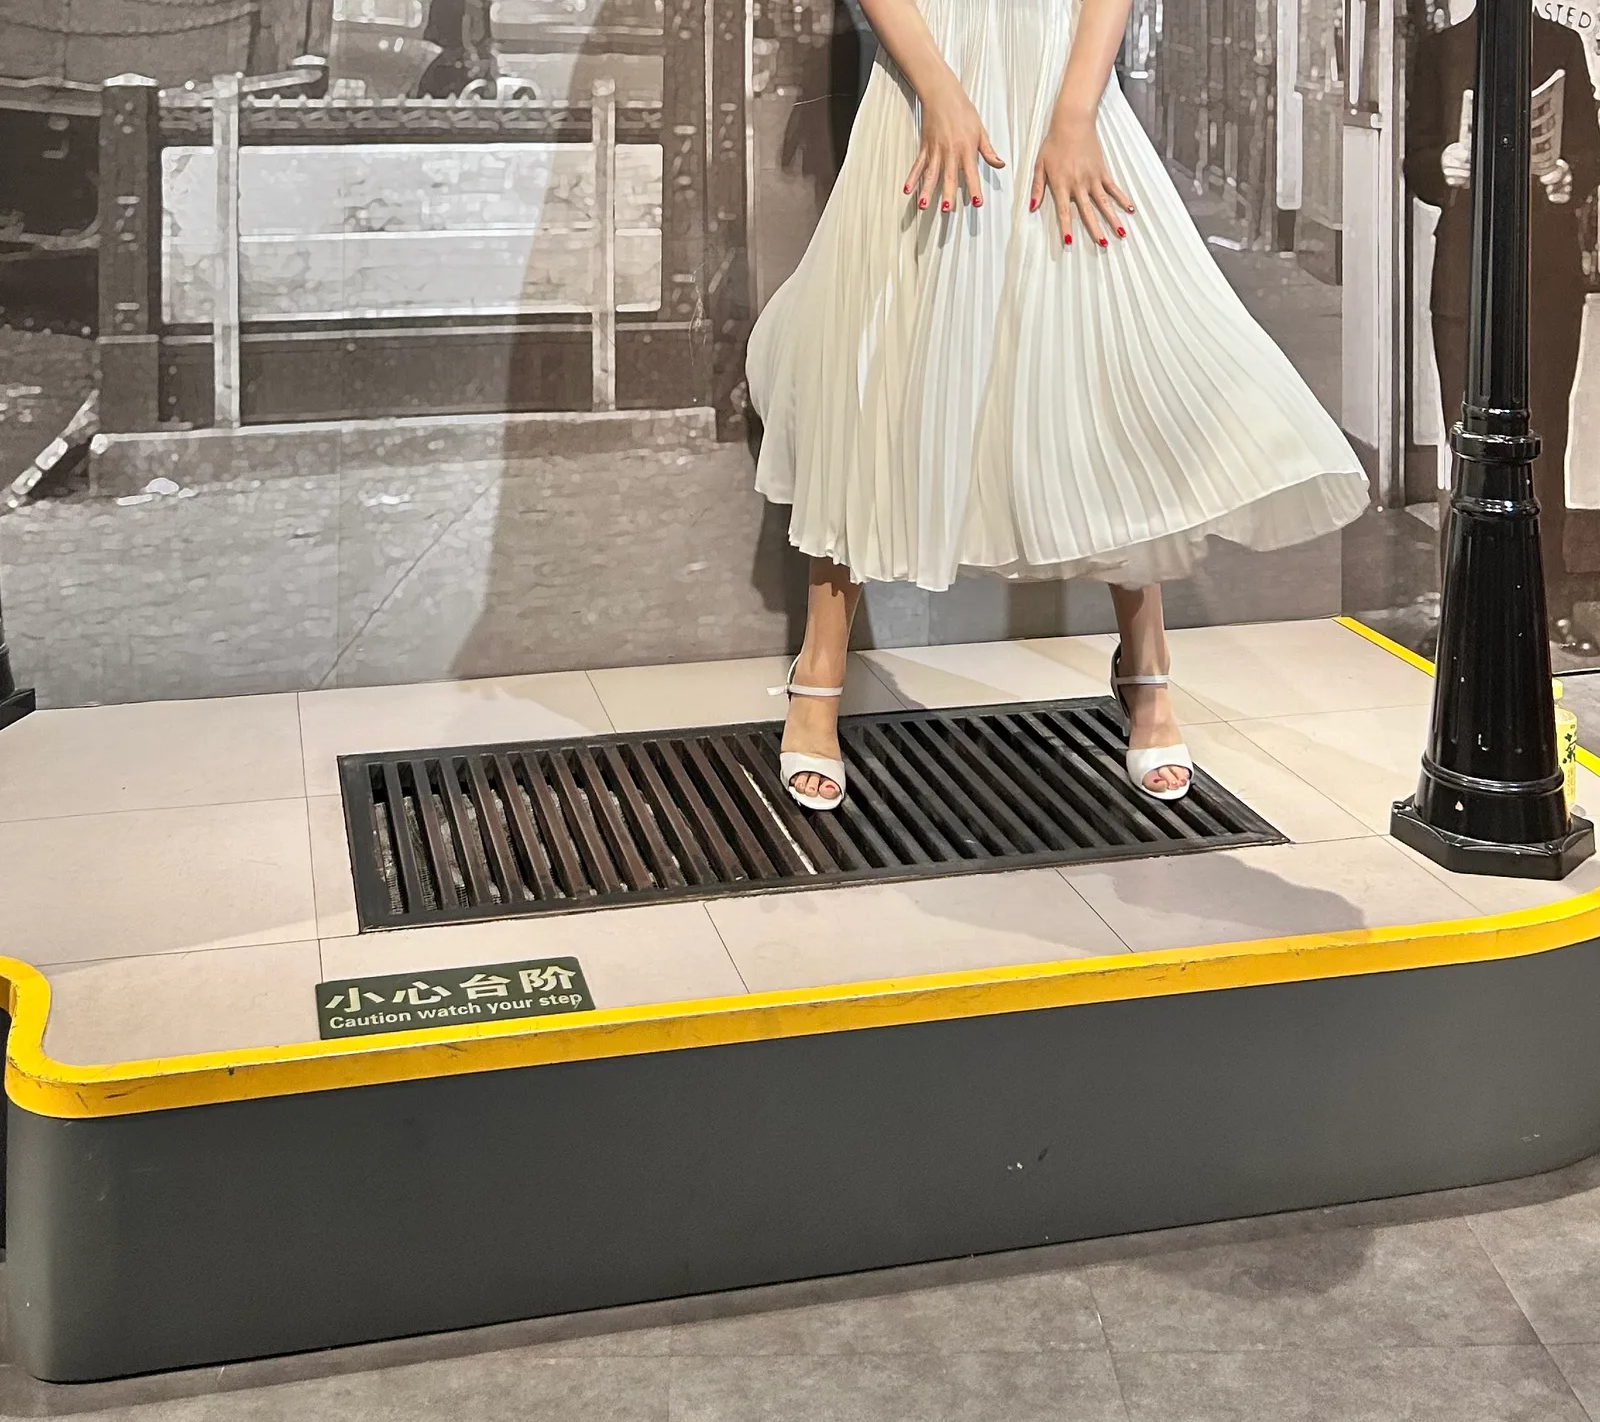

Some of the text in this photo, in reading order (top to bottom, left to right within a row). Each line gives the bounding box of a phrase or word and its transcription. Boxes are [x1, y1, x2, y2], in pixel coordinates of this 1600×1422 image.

[325, 965, 577, 1013] 小心台阶
[329, 993, 583, 1029] Caution watch your step
